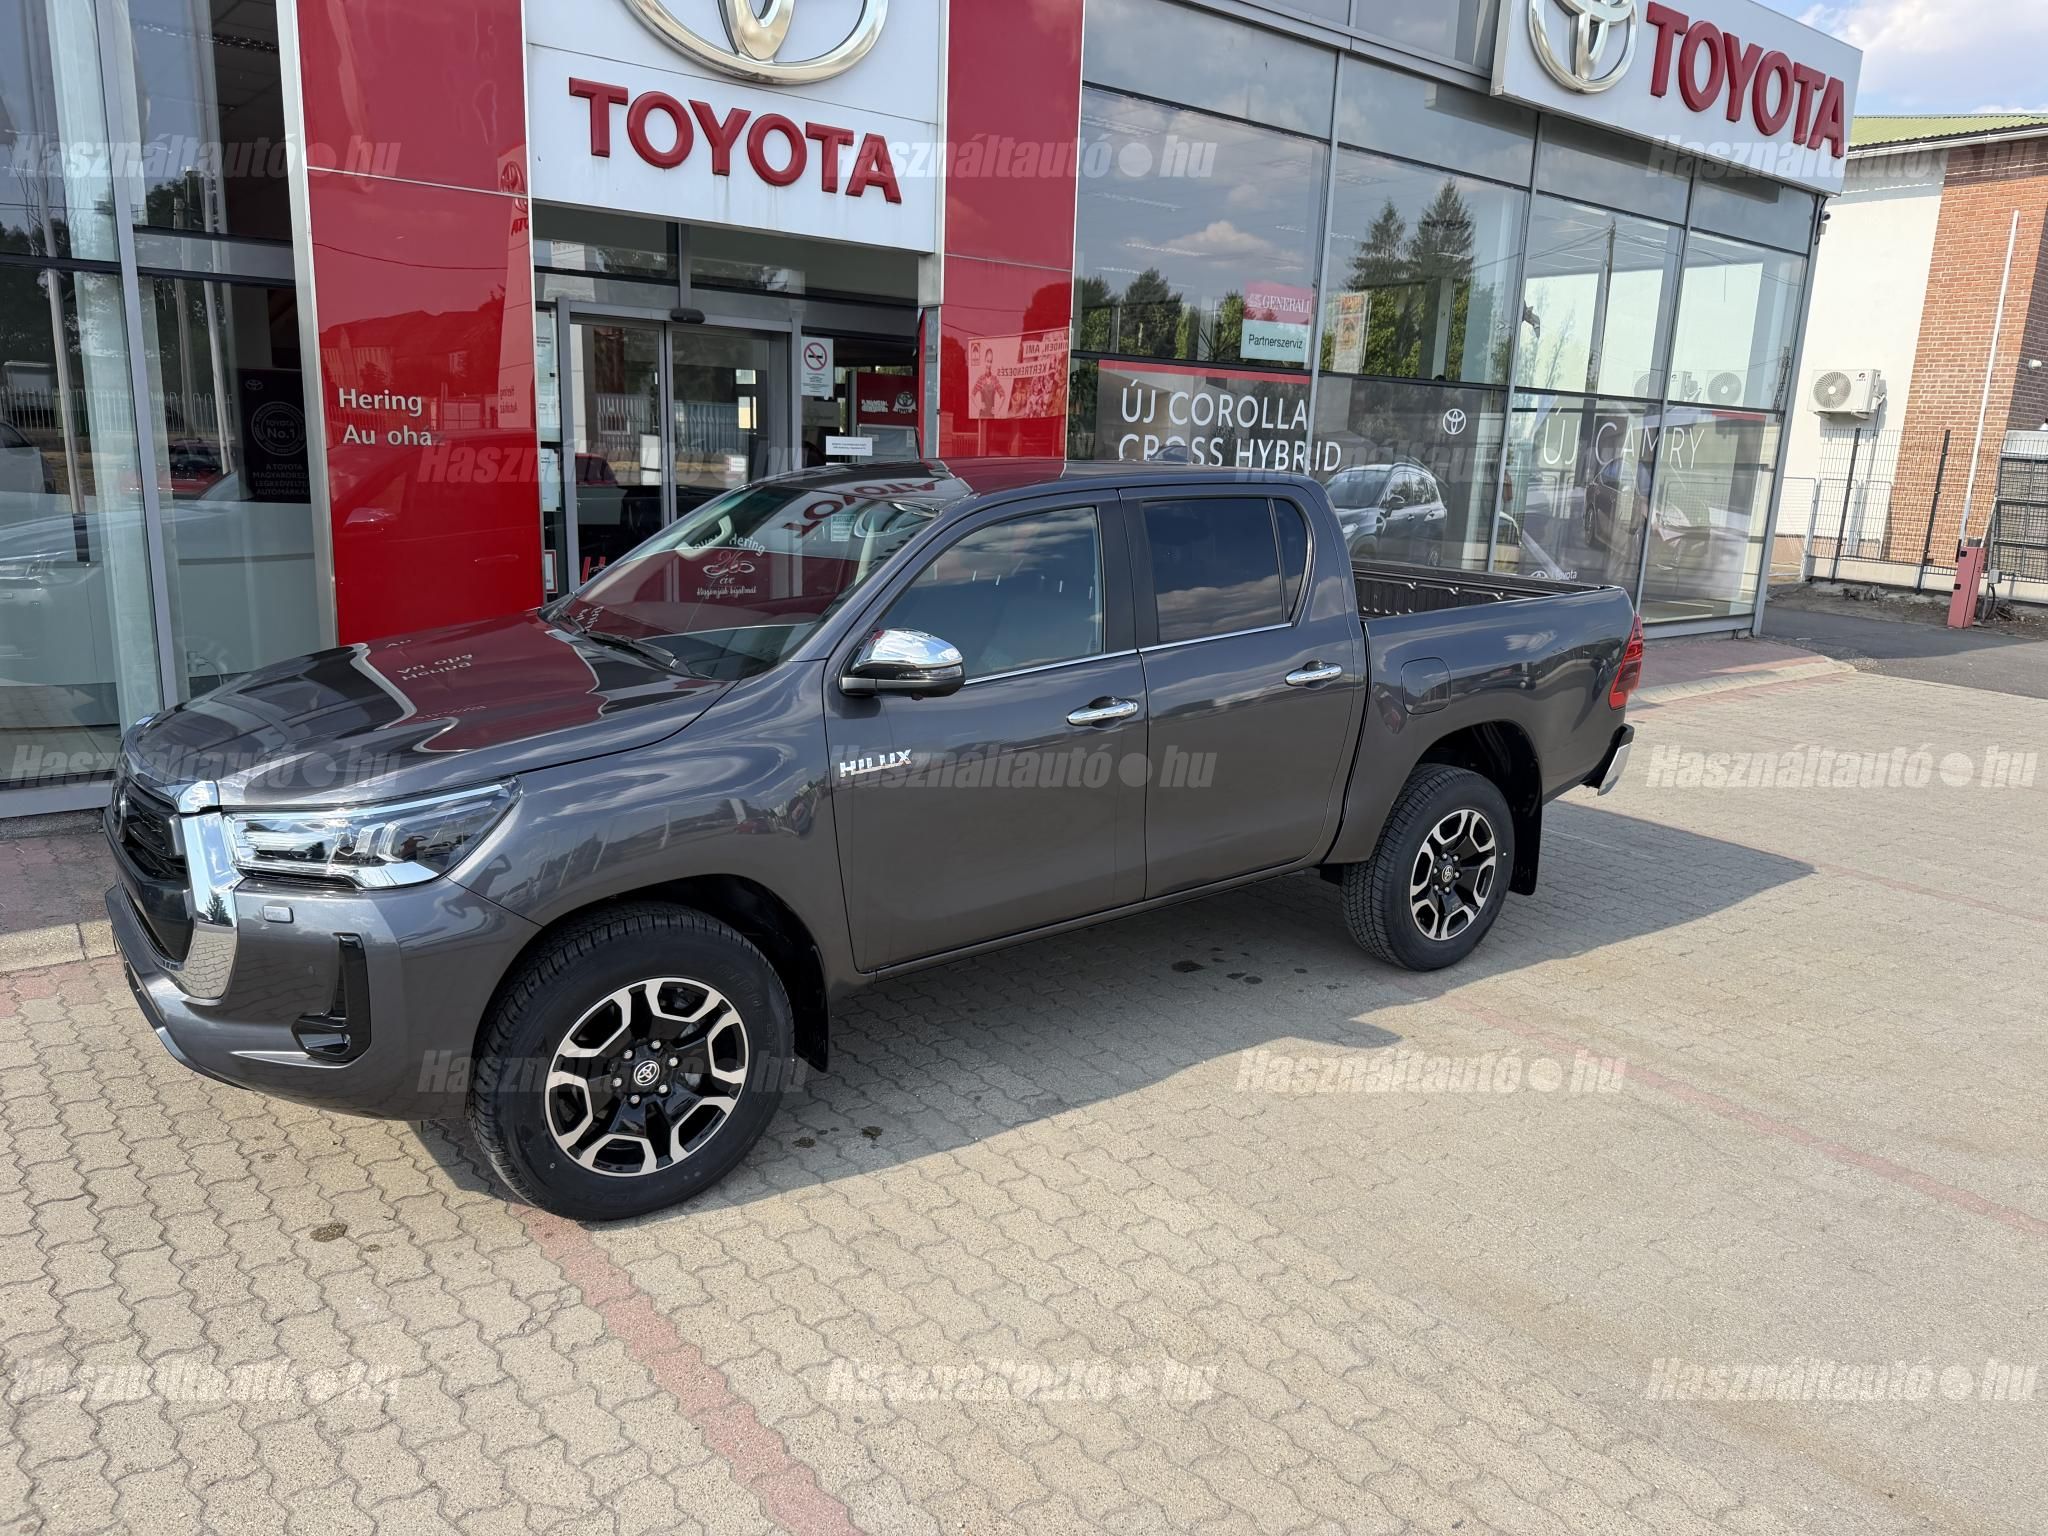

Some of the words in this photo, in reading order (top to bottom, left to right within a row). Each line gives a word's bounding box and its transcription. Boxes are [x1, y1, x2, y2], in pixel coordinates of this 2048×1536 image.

[1645, 1, 1847, 160] TOYOTA
[568, 76, 902, 204] TOYOTA
[1262, 294, 1311, 314] GENERALI
[338, 387, 423, 417] Hering
[1121, 379, 1156, 423] ÚJ
[1168, 391, 1308, 431] COROLLA
[1235, 438, 1342, 472] HYBRID
[1543, 406, 1580, 465] ÚJ
[1595, 422, 1705, 470] CAMRY
[840, 748, 912, 778] HILUX
